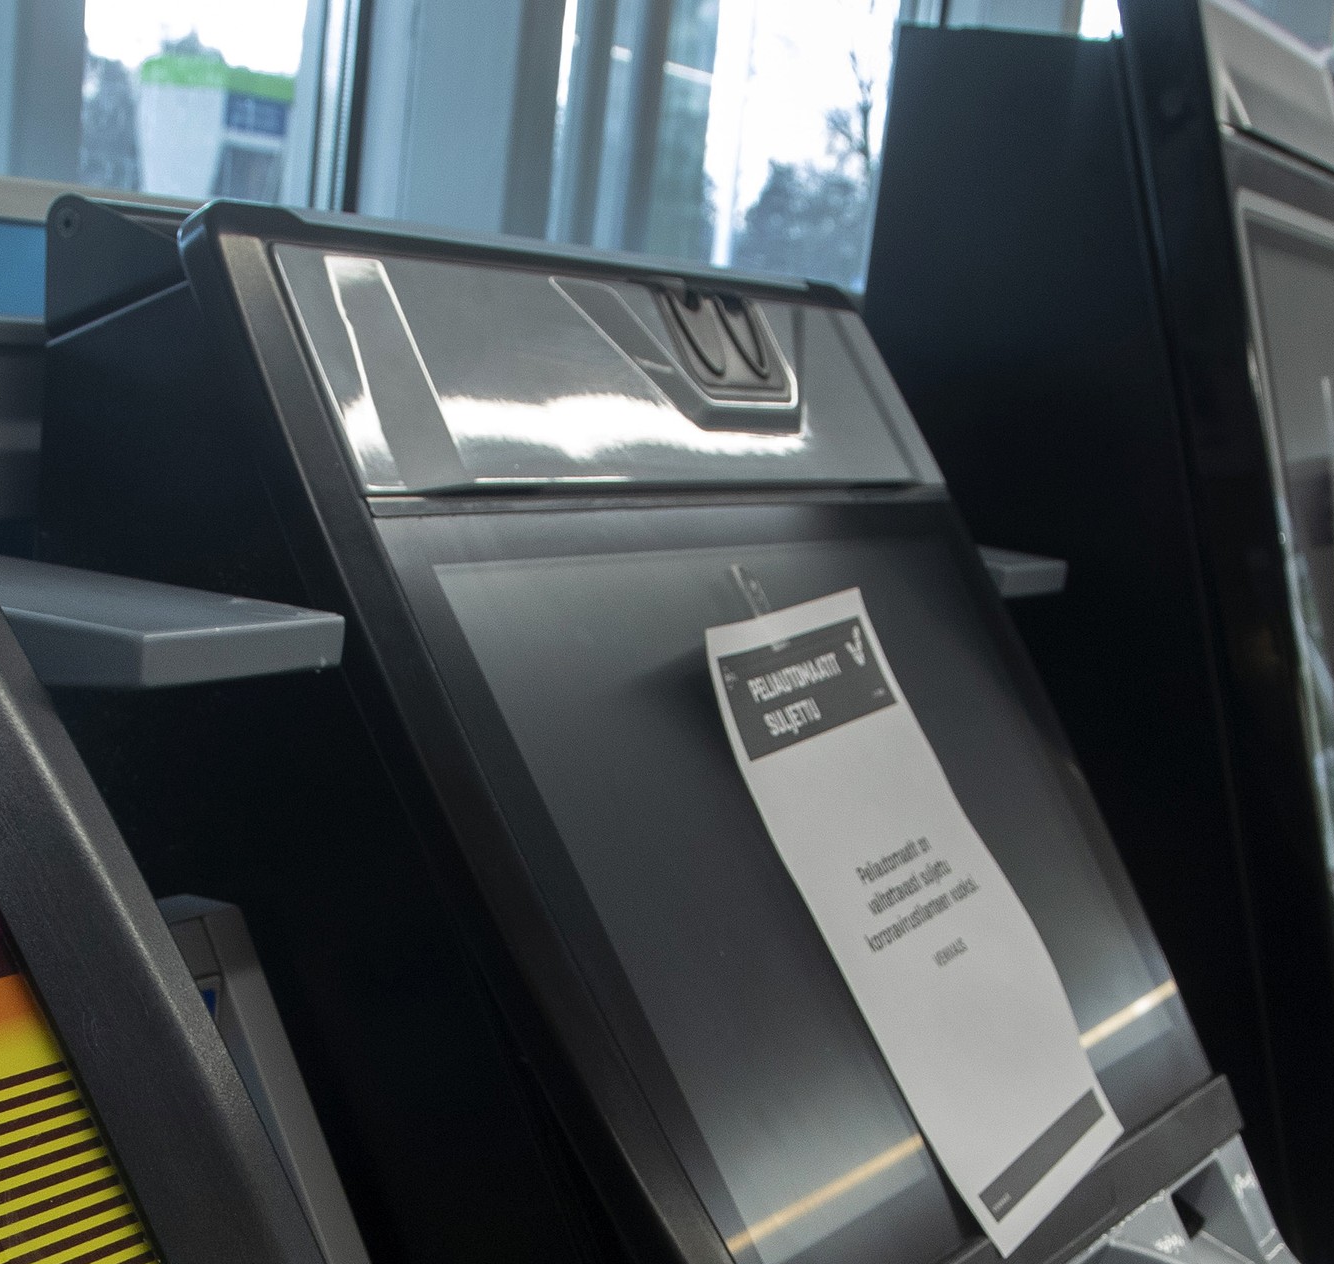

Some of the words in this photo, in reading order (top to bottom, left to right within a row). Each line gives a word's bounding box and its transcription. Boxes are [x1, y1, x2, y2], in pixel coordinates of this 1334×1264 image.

[746, 651, 843, 704] PELIAUTOMAATIT
[763, 696, 822, 738] SULJETTU
[855, 839, 920, 886] Peliautomaatit
[868, 871, 922, 916] valitettavasti
[919, 858, 953, 888] suljettu
